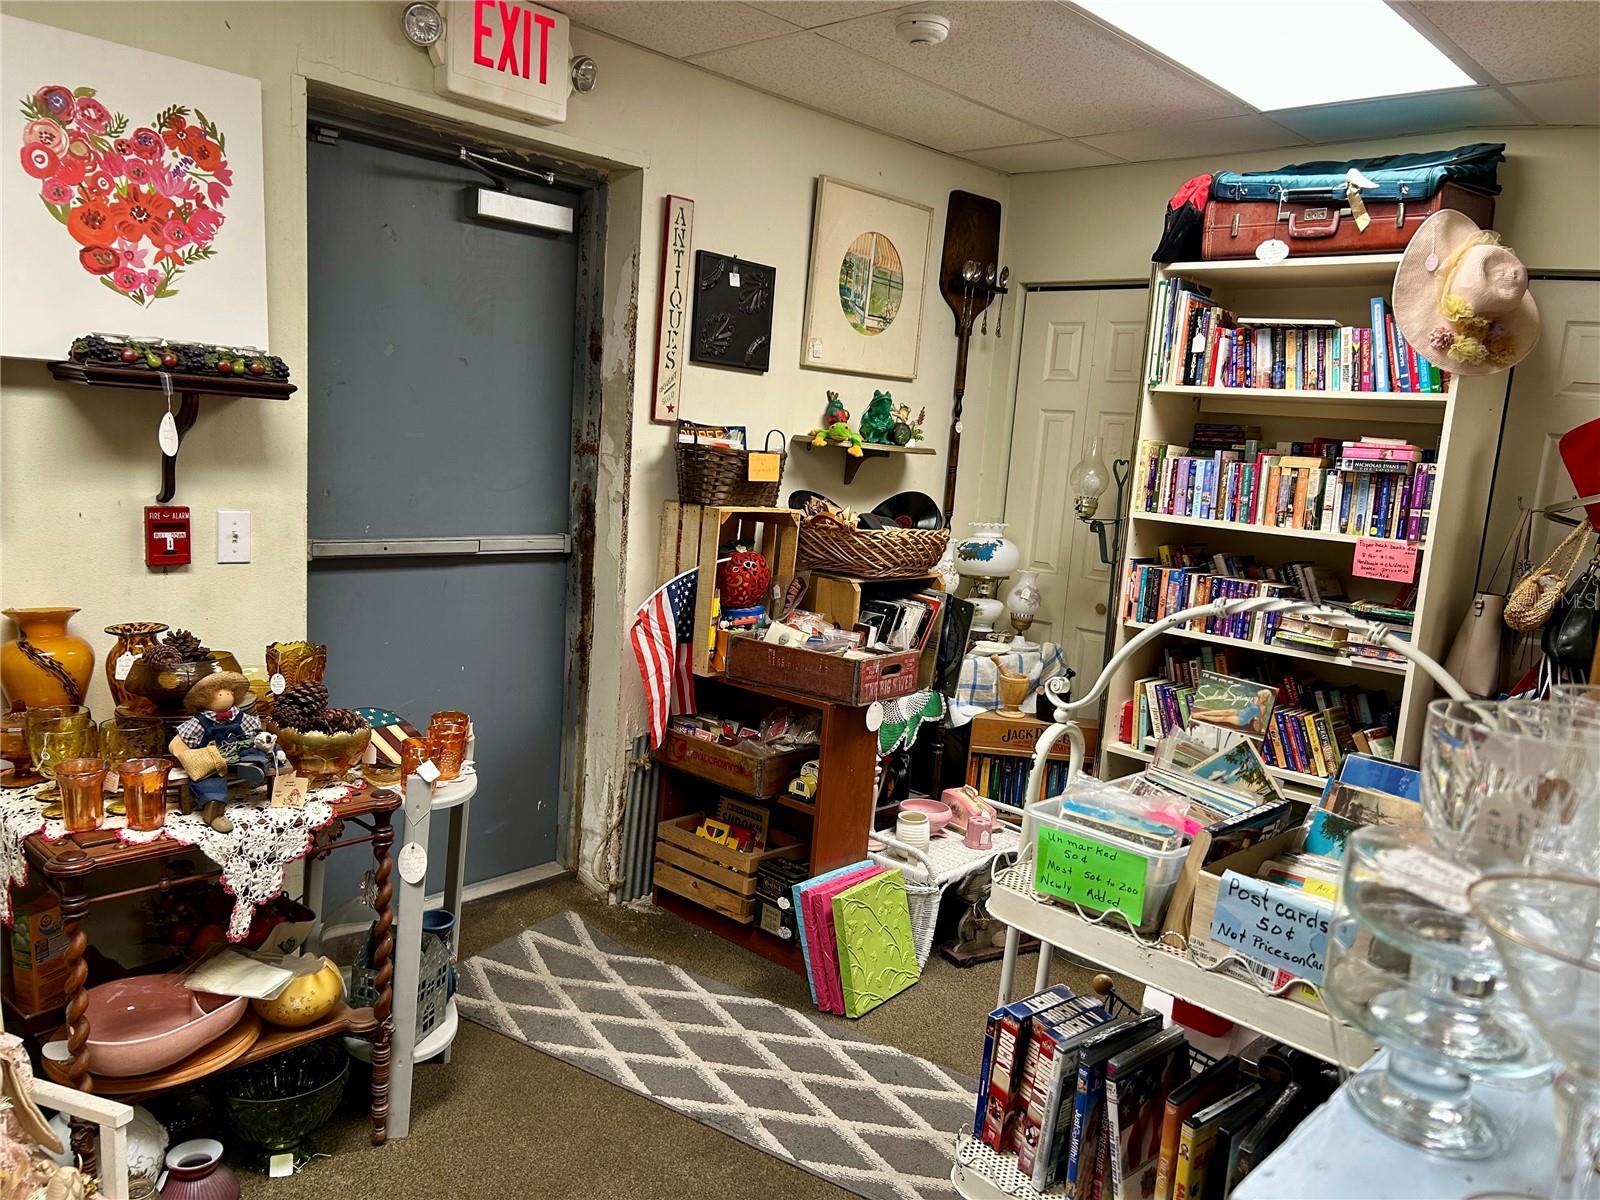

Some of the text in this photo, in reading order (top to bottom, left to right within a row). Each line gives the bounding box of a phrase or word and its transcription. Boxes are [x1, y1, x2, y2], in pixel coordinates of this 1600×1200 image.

[473, 0, 555, 84] EXIT
[665, 207, 686, 369] ANTIQUES
[149, 512, 190, 520] FIRE ALARM
[1001, 729, 1033, 742] JACK
[1047, 860, 1073, 875] Most
[1107, 877, 1115, 887] to
[1040, 874, 1121, 908] Newly Added
[1217, 922, 1246, 943] Not
[1256, 917, 1295, 942] 50¢
[1040, 1001, 1083, 1023] ROCKY
[1052, 1011, 1104, 1039] ROCKY V
[995, 1028, 1016, 1078] ROCKY
[1073, 1109, 1082, 1128] Just
[1096, 1130, 1108, 1173] PRESSURE
